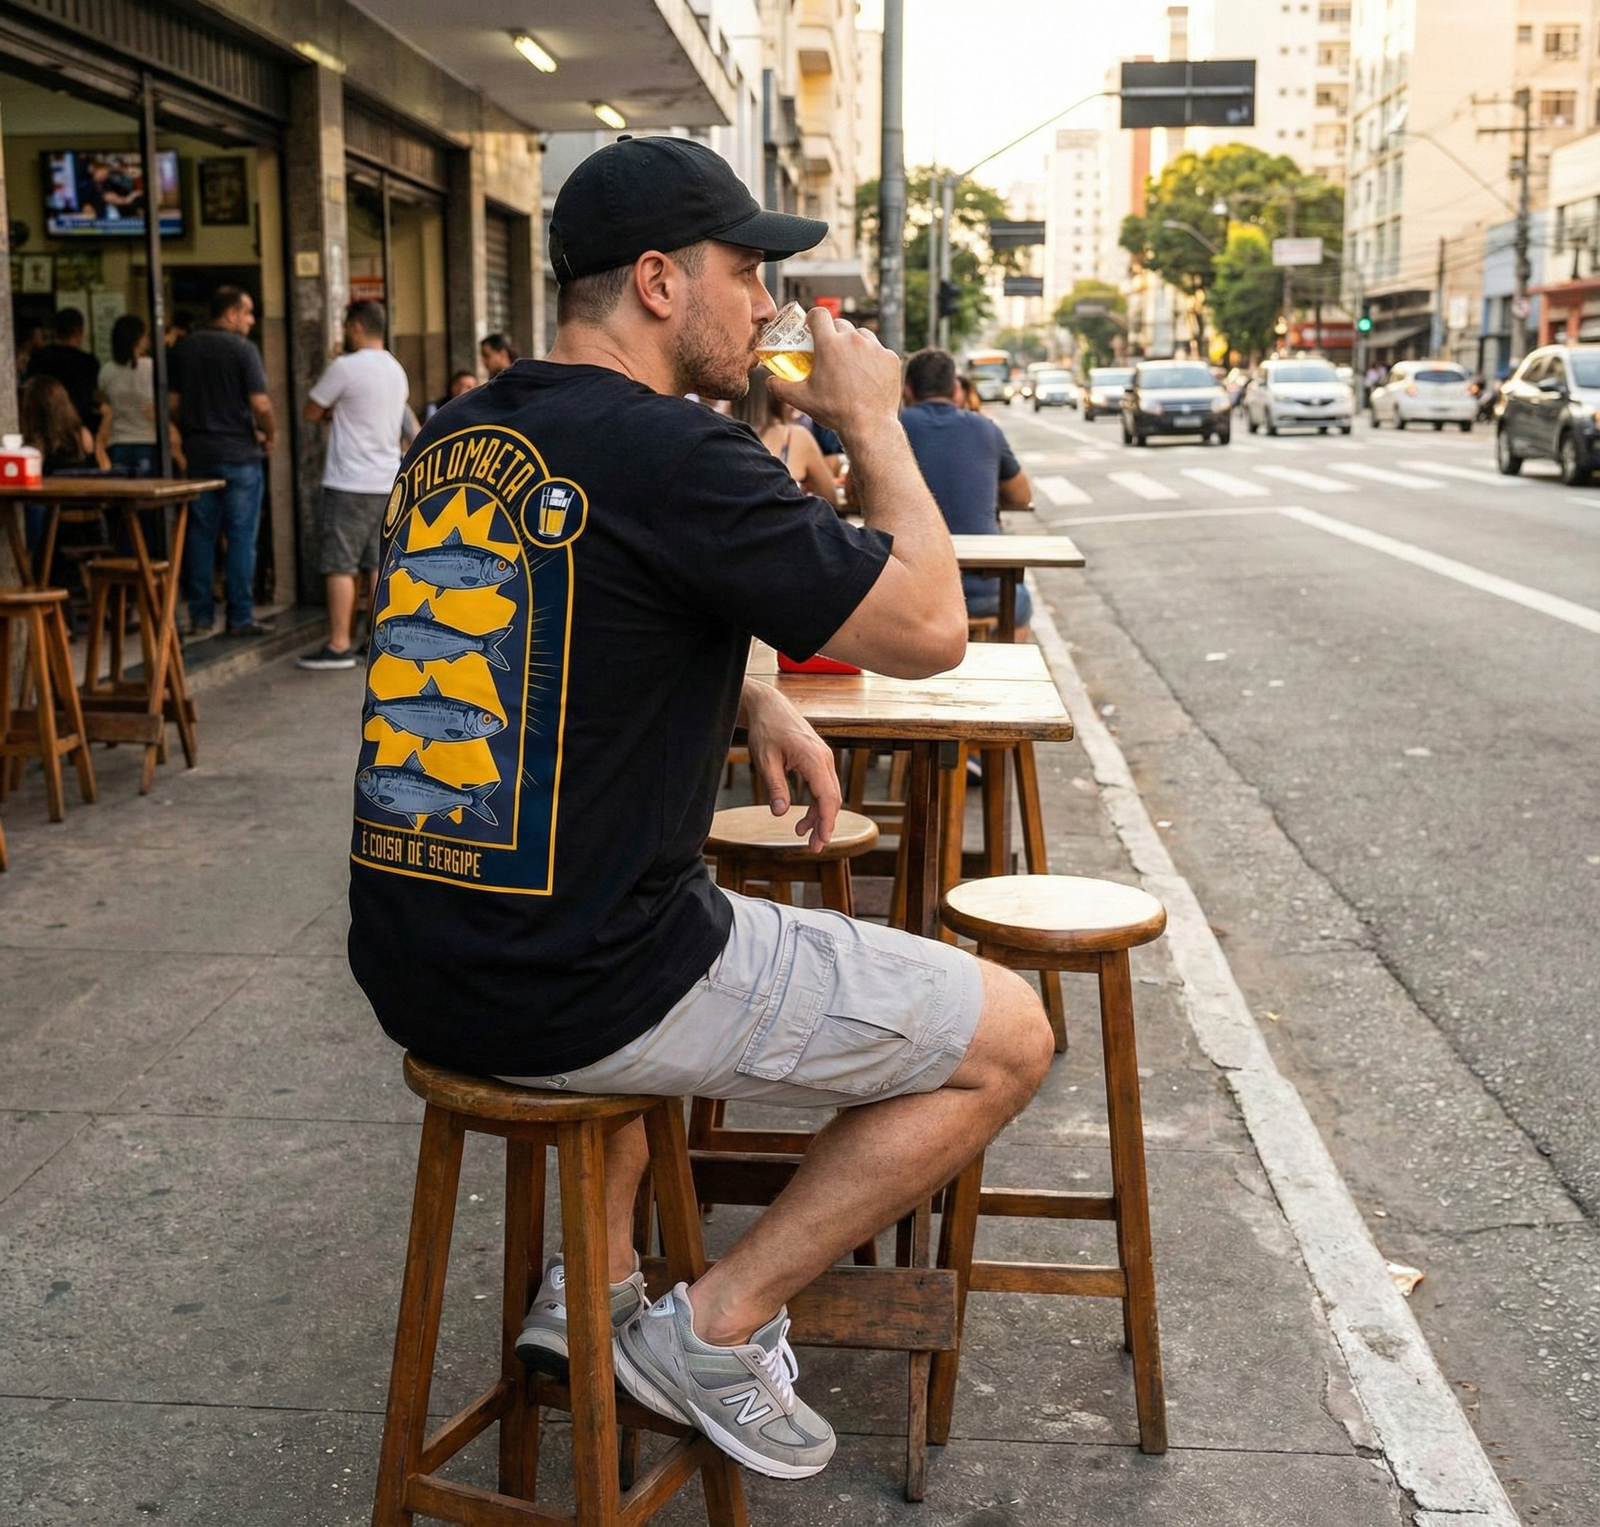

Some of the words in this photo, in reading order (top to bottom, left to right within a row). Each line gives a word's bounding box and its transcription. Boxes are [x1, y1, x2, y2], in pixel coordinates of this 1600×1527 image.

[413, 436, 536, 503] PILOMBETA
[370, 832, 402, 863] COISA
[407, 840, 424, 867] DE
[428, 844, 482, 878] SERGIPE
[721, 1386, 773, 1426] N
